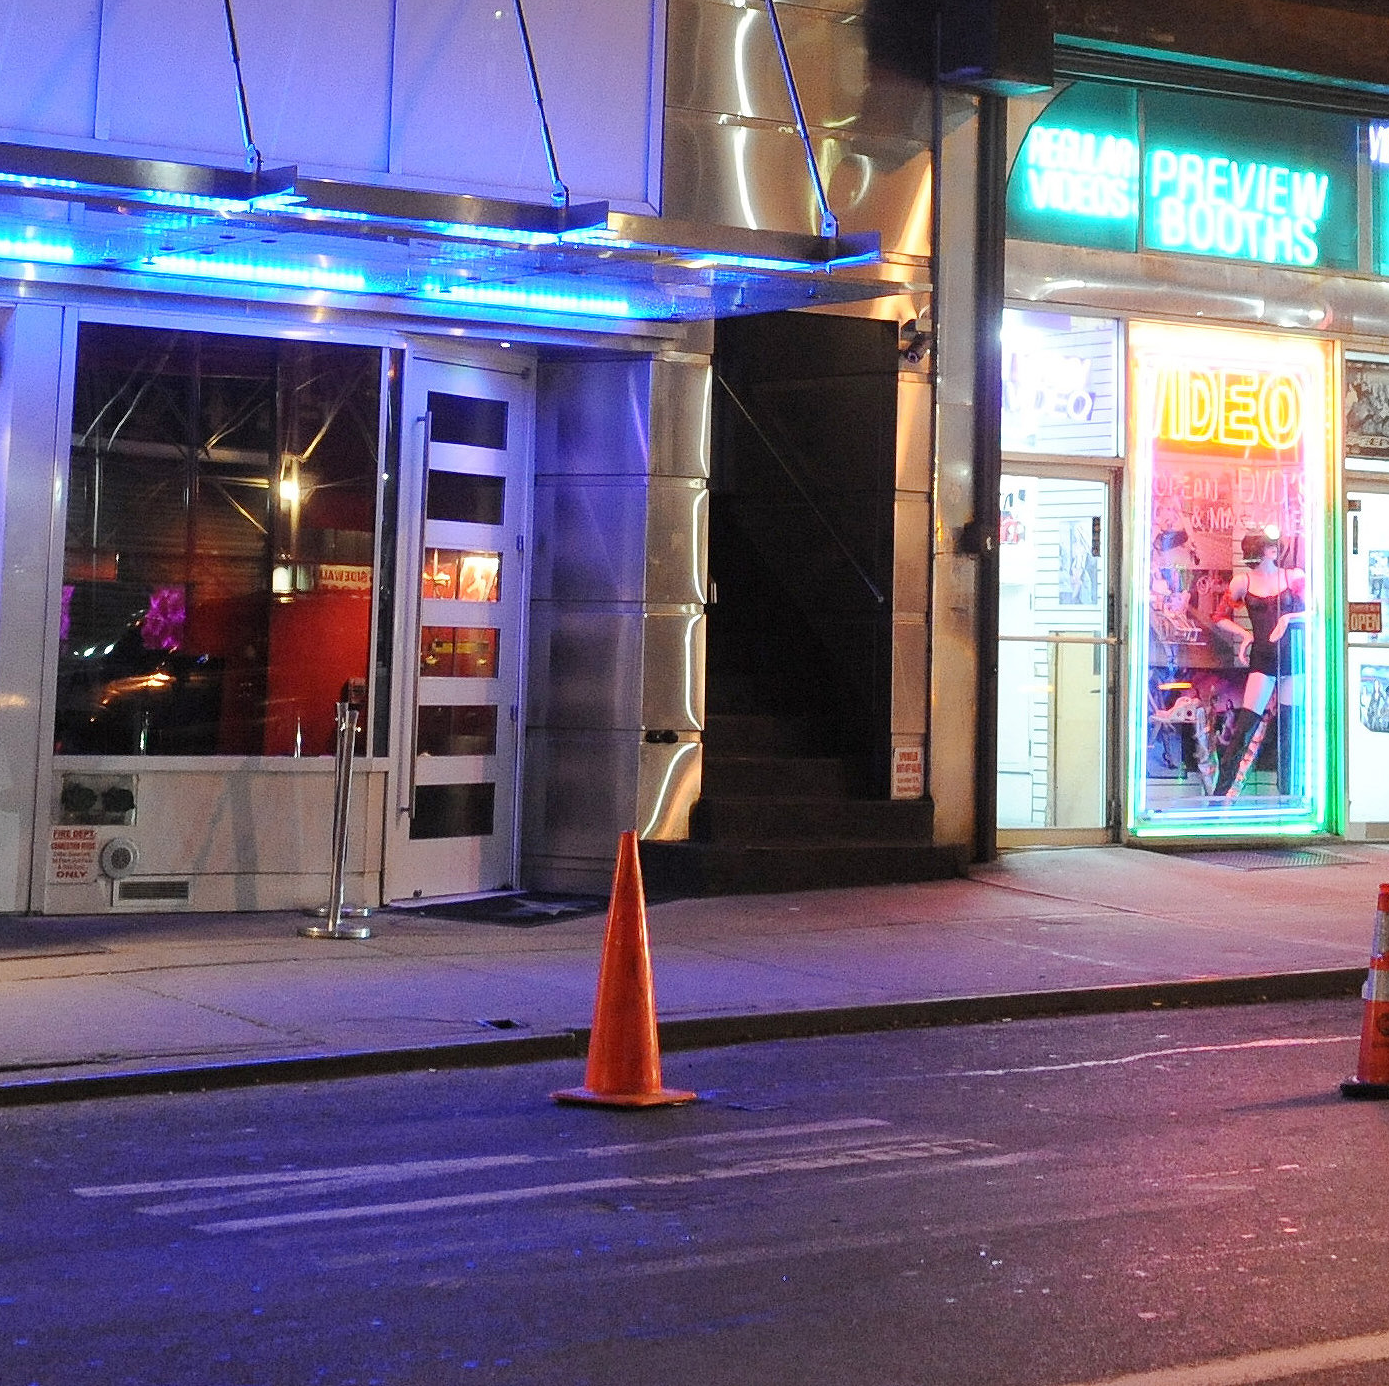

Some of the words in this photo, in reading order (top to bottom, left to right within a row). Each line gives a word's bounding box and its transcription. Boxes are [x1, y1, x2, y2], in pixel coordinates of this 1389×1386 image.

[1028, 125, 1136, 178] REGULAR
[1028, 168, 1131, 219] VIDEOS
[1152, 149, 1329, 221] PREVIEW
[1157, 197, 1320, 266] BOOTHS
[1349, 614, 1381, 632] OPEN
[56, 870, 88, 879] ONLY
